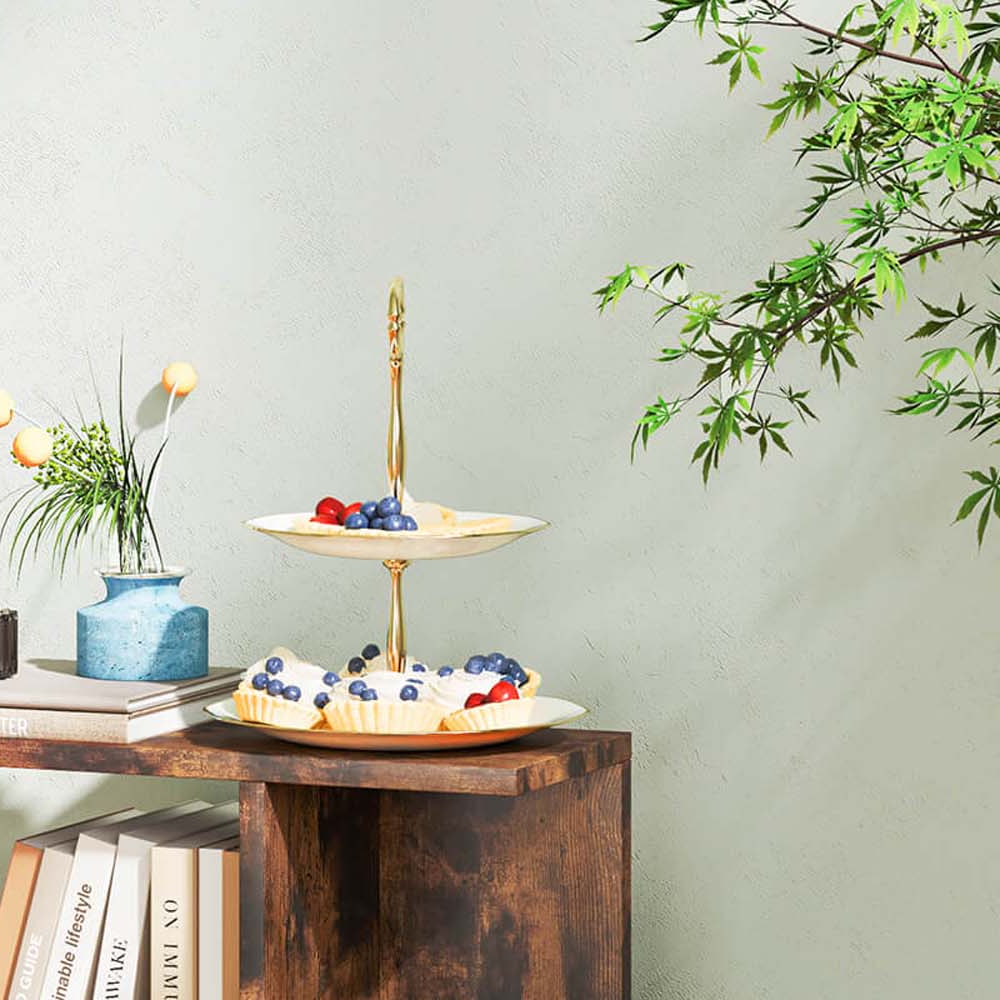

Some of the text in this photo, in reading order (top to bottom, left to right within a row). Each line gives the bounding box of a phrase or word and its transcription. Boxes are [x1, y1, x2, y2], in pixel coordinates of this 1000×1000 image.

[64, 883, 93, 948] lifestyle
[162, 899, 179, 929] ON
[19, 934, 43, 989] GUIDE
